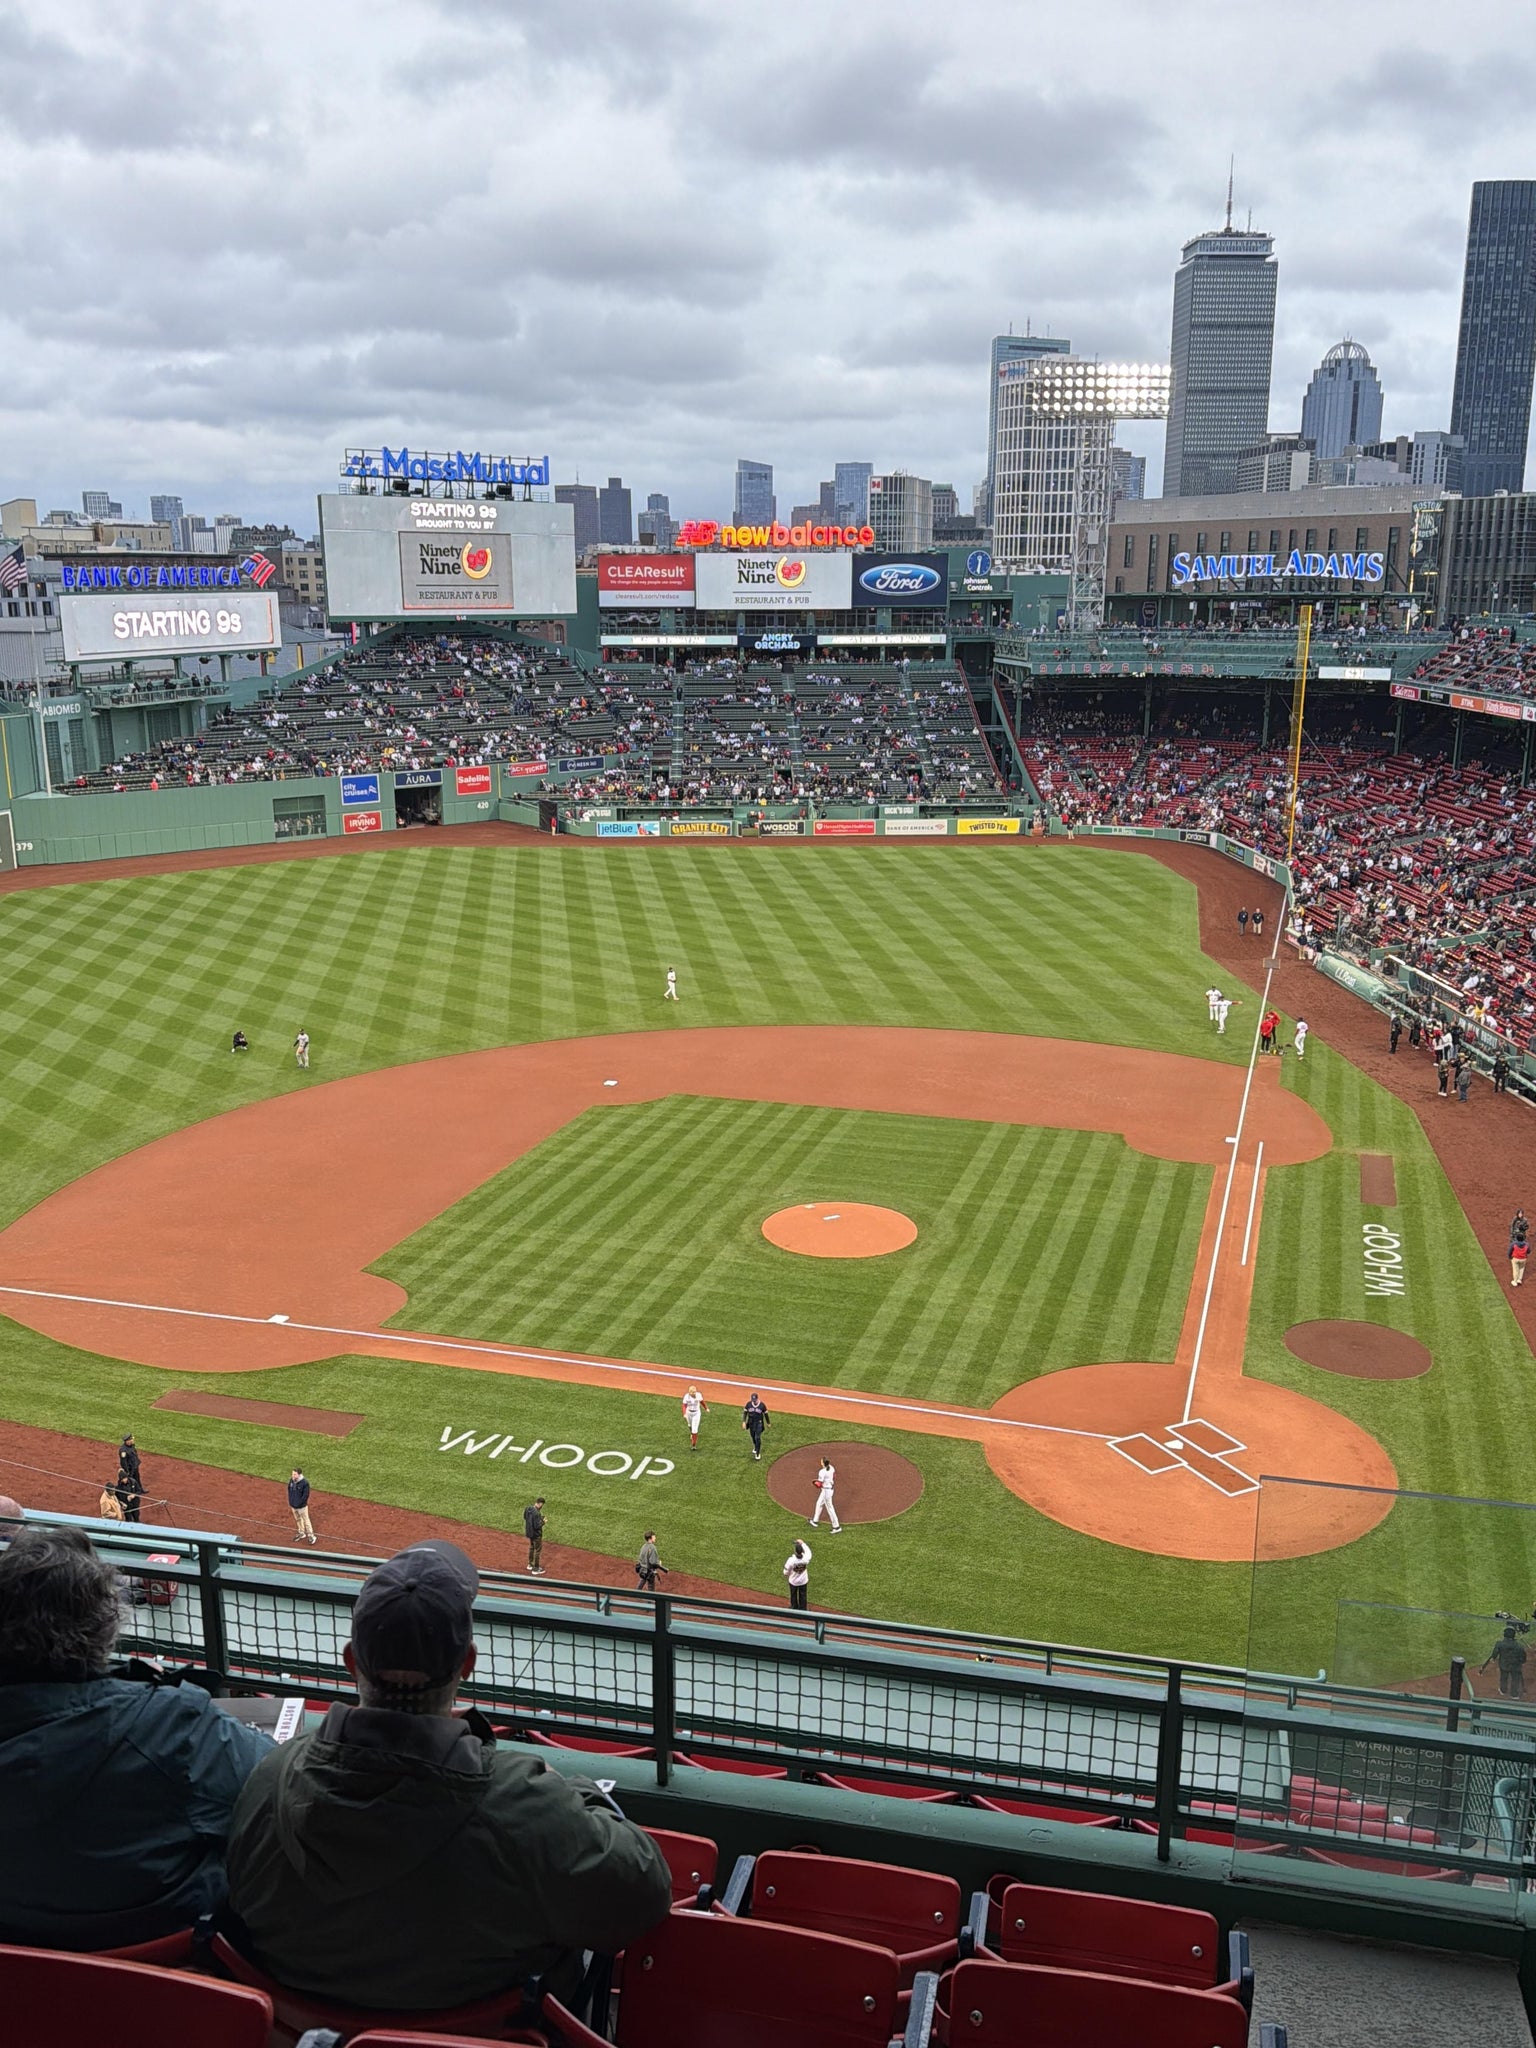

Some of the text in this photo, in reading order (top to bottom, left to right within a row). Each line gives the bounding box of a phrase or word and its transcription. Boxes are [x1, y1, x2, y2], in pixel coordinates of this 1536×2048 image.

[382, 447, 549, 485] MassMutual
[411, 502, 475, 517] STARTING
[416, 519, 494, 529] BROUGHT TO YOU BY
[419, 544, 462, 559] Ninety
[420, 558, 461, 575] Nine
[737, 558, 777, 570] Ninety
[1172, 548, 1384, 585] SAMUEL ADAMS
[62, 566, 241, 588] BANK OF AMERICA
[607, 565, 685, 578] CLEAResult
[737, 570, 776, 584] Nine
[876, 564, 924, 590] Ford
[963, 577, 988, 585] Johnson
[419, 591, 498, 600] RESTAURANT & PUB
[735, 596, 786, 604] RESTAURANT
[794, 596, 810, 604] PUB
[113, 610, 241, 639] STARTING 9s
[761, 633, 794, 642] ANGRY
[754, 641, 801, 650] ORCHARD
[1222, 664, 1234, 674] 42
[42, 703, 81, 717] ABIOMED
[458, 774, 490, 784] Safelite
[344, 783, 356, 791] city
[344, 789, 368, 797] cruises
[477, 801, 489, 809] 420
[350, 818, 376, 827] IRVING
[672, 823, 710, 834] GRANITE
[710, 822, 730, 834] CITY
[762, 822, 798, 831] wasabi
[969, 823, 1008, 832] TWISTED TEA
[601, 823, 633, 835] jetBlue
[16, 842, 33, 851] 379
[1363, 1224, 1405, 1296] WHOOP
[439, 1426, 675, 1480] WHOOP
